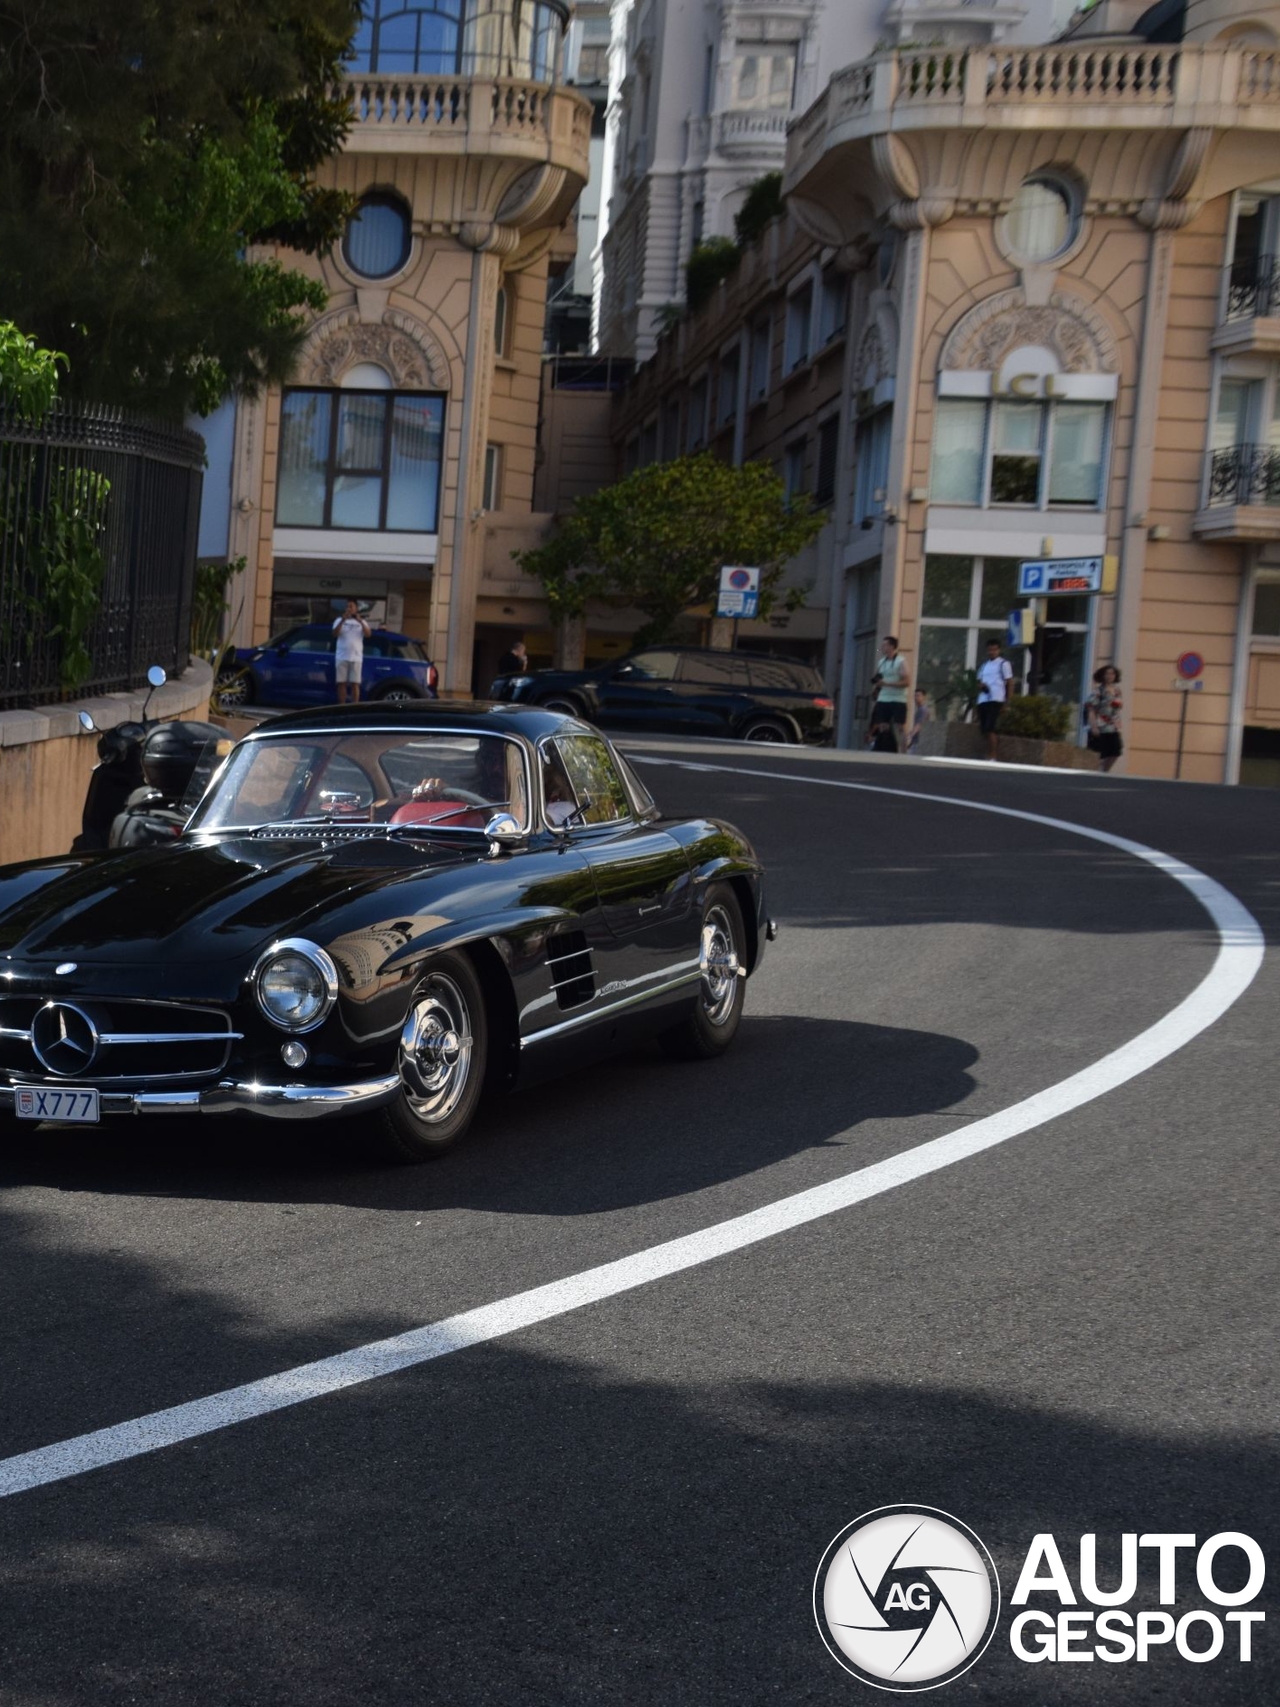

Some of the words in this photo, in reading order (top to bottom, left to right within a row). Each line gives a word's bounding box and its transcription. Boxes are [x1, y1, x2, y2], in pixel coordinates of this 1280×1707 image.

[991, 371, 1067, 398] LCL
[1027, 569, 1040, 587] P
[36, 1092, 93, 1117] X777
